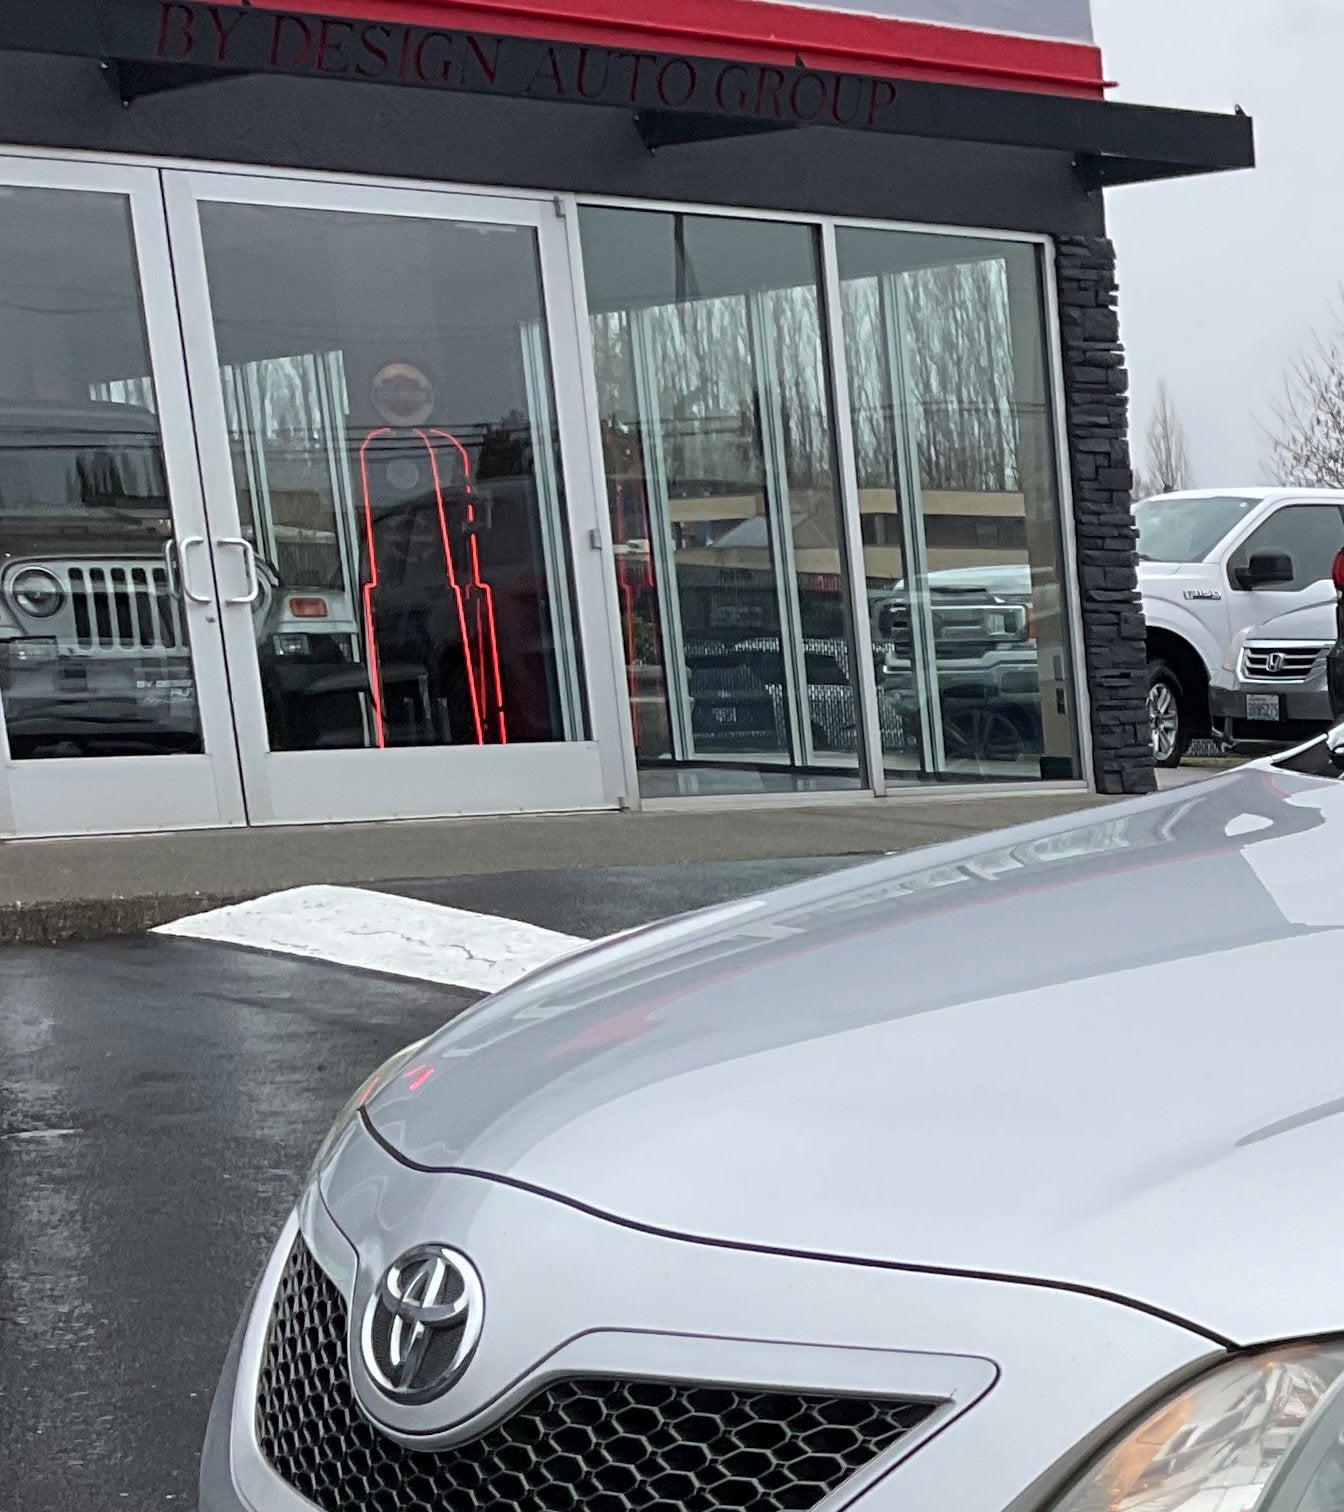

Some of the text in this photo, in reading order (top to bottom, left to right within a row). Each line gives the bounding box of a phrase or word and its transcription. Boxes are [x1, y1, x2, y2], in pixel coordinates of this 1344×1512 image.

[156, 3, 897, 126] BY DESIGN AUTO GROUP
